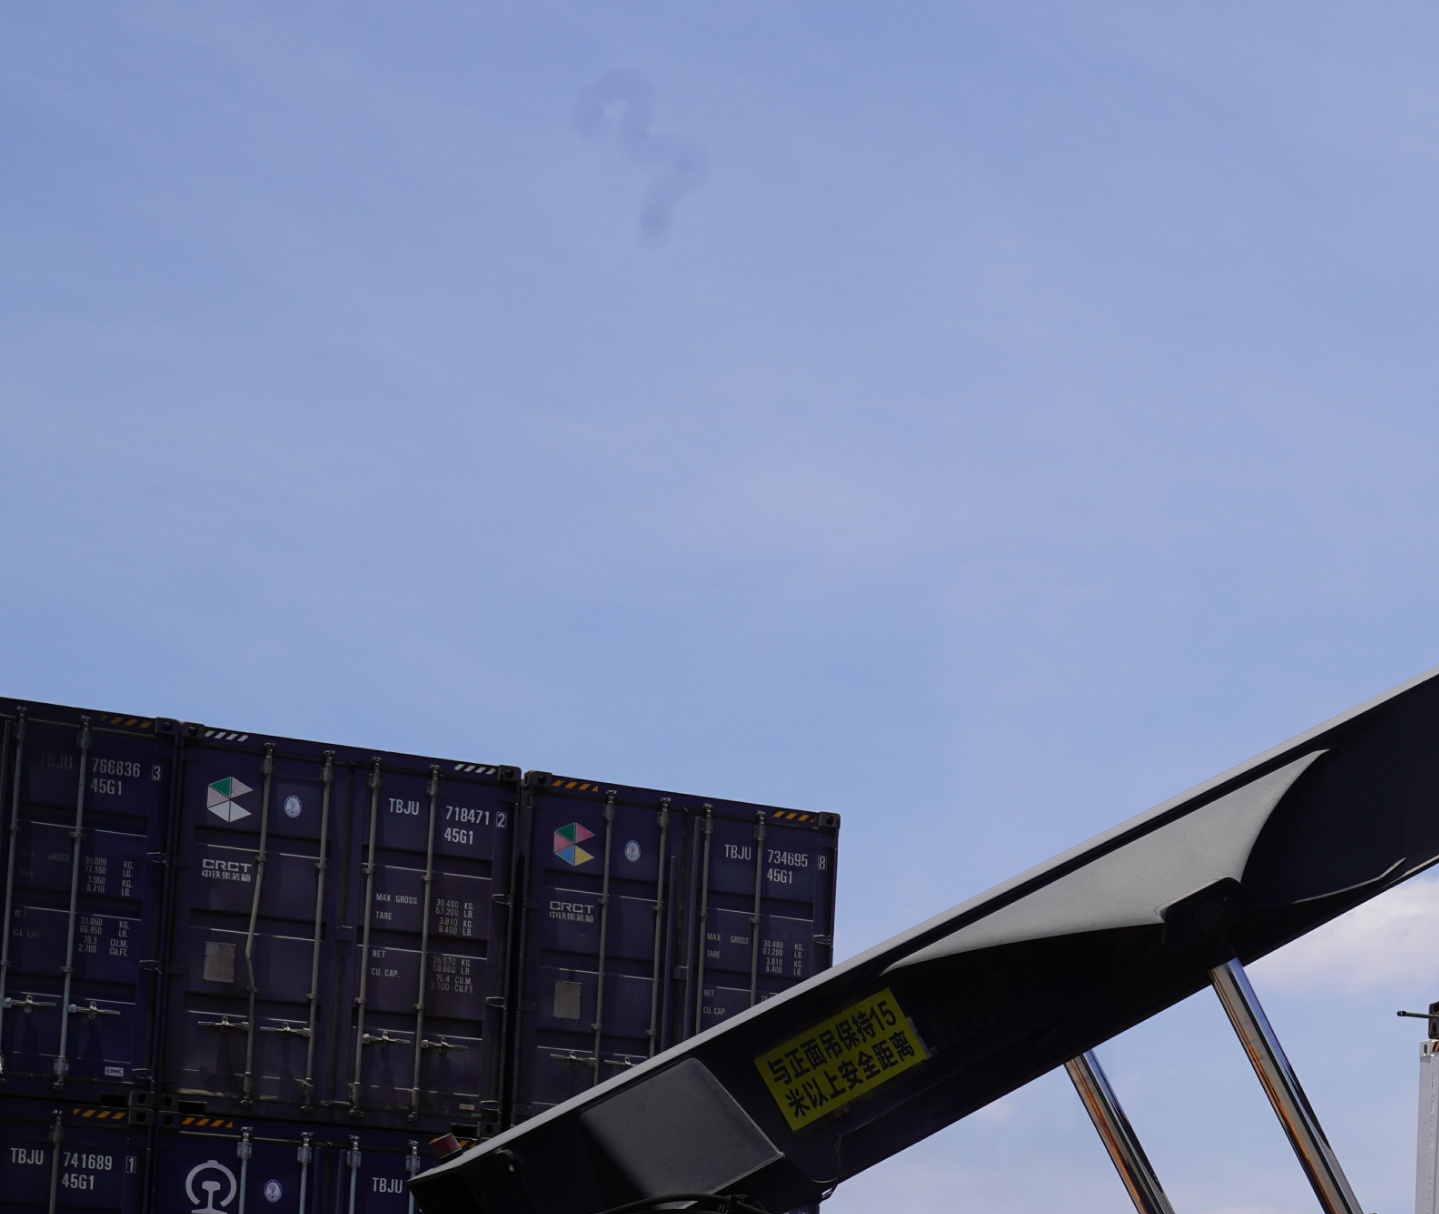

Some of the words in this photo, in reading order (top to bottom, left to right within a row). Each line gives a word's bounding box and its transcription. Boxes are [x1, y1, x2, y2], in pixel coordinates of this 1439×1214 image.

[92, 757, 141, 778] 766836
[153, 765, 161, 780] 3
[90, 778, 122, 796] 45G1
[388, 797, 420, 816] TBJU
[445, 806, 490, 825] 718471
[497, 814, 506, 827] 2
[444, 827, 474, 845] 45G1
[724, 844, 752, 861] TBJU
[768, 849, 809, 868] 734695
[819, 856, 826, 869] 8
[203, 859, 252, 872] CRCT
[201, 870, 251, 882] 中铁集装箱
[767, 868, 793, 884] 45G1
[376, 893, 391, 902] MAX
[395, 895, 418, 905] GROSS
[549, 900, 595, 914] CRCT
[375, 911, 393, 920] TARE
[707, 932, 721, 942] MAX
[730, 935, 749, 945] GROSS
[372, 950, 386, 958] NET
[706, 949, 721, 959] TARE
[703, 988, 715, 997] NET
[766, 1000, 897, 1087] 与正面吊保持15
[784, 1030, 916, 1119] 米以上安全距离
[10, 1148, 44, 1166] TBJU
[63, 1152, 113, 1171] 741689
[128, 1158, 135, 1173] 1
[62, 1173, 95, 1190] 45G1
[372, 1177, 403, 1194] TBJU
